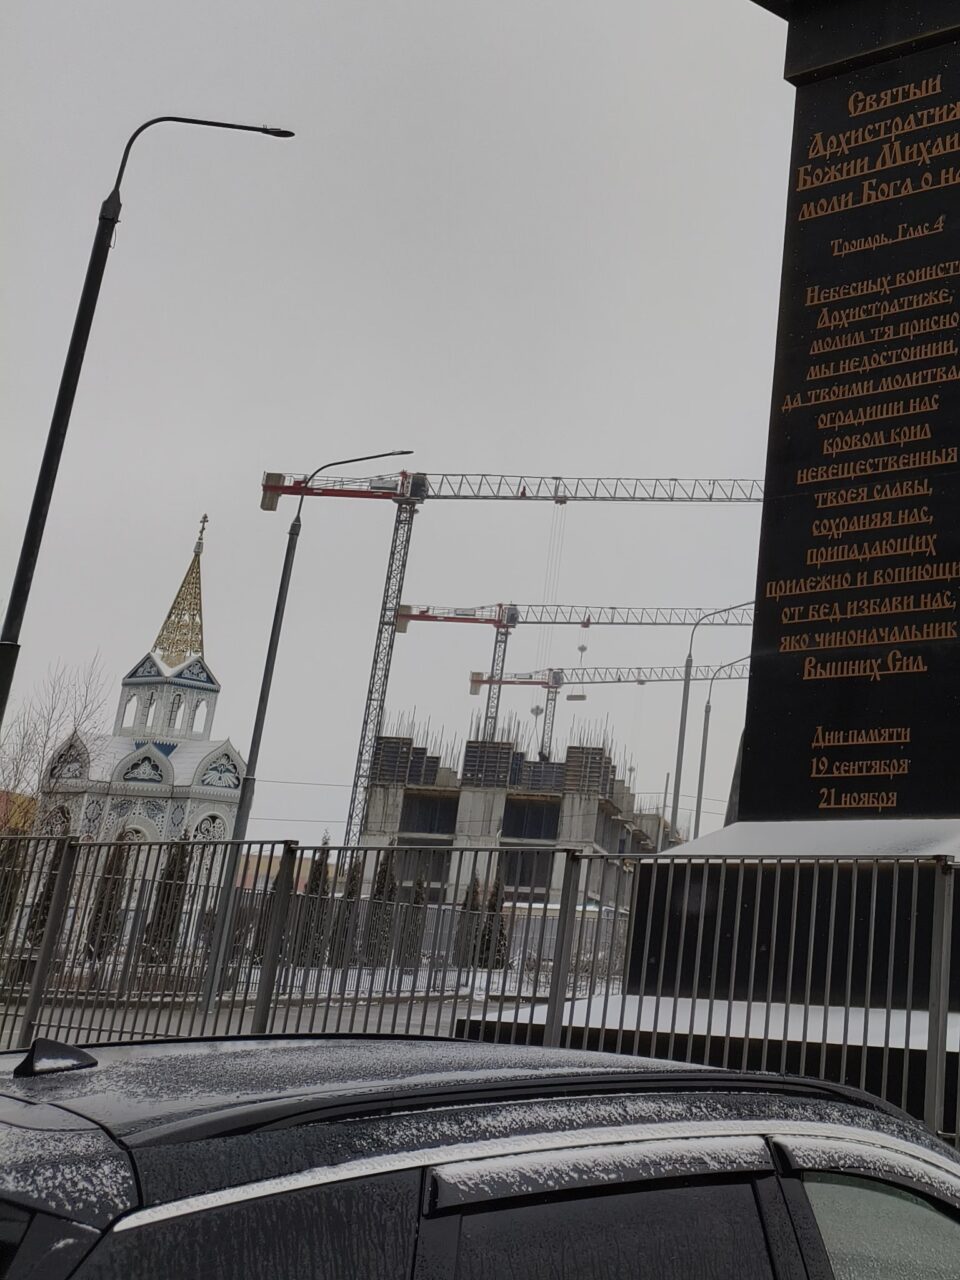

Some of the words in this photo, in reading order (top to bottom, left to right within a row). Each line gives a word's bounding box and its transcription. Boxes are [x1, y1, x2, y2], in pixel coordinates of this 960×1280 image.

[798, 192, 853, 221] моли
[861, 177, 913, 205] Бога
[921, 173, 933, 190] о
[897, 223, 929, 240] Глас
[933, 215, 945, 232] 4
[805, 275, 891, 306] Небесных
[817, 289, 953, 330] Архистратиже,
[809, 330, 865, 355] молим
[871, 325, 894, 342] тя
[899, 312, 960, 339] присно
[806, 361, 835, 380] мы
[782, 392, 801, 412] да
[807, 380, 873, 404] твоими
[817, 401, 904, 429] оградиши
[910, 394, 939, 412] нас
[823, 431, 885, 457] кровом
[890, 423, 931, 446] крил
[796, 447, 958, 485] невещественныя
[815, 487, 868, 508] твоея
[873, 478, 932, 498] славы,
[812, 510, 892, 539] сохраняя
[806, 534, 936, 568] припадающих
[766, 573, 851, 602] прилежно
[857, 571, 868, 587] и
[781, 605, 803, 623] от
[808, 600, 841, 622] бед
[846, 594, 915, 618] избави
[779, 633, 810, 652] яко
[815, 621, 958, 649] чиноначальник
[803, 655, 881, 680] Вышних
[812, 726, 844, 748] Дни
[848, 726, 911, 743] памяти
[811, 757, 828, 777] 19
[832, 758, 910, 779] сентября
[818, 788, 836, 808] 21
[841, 791, 897, 811] ноября
